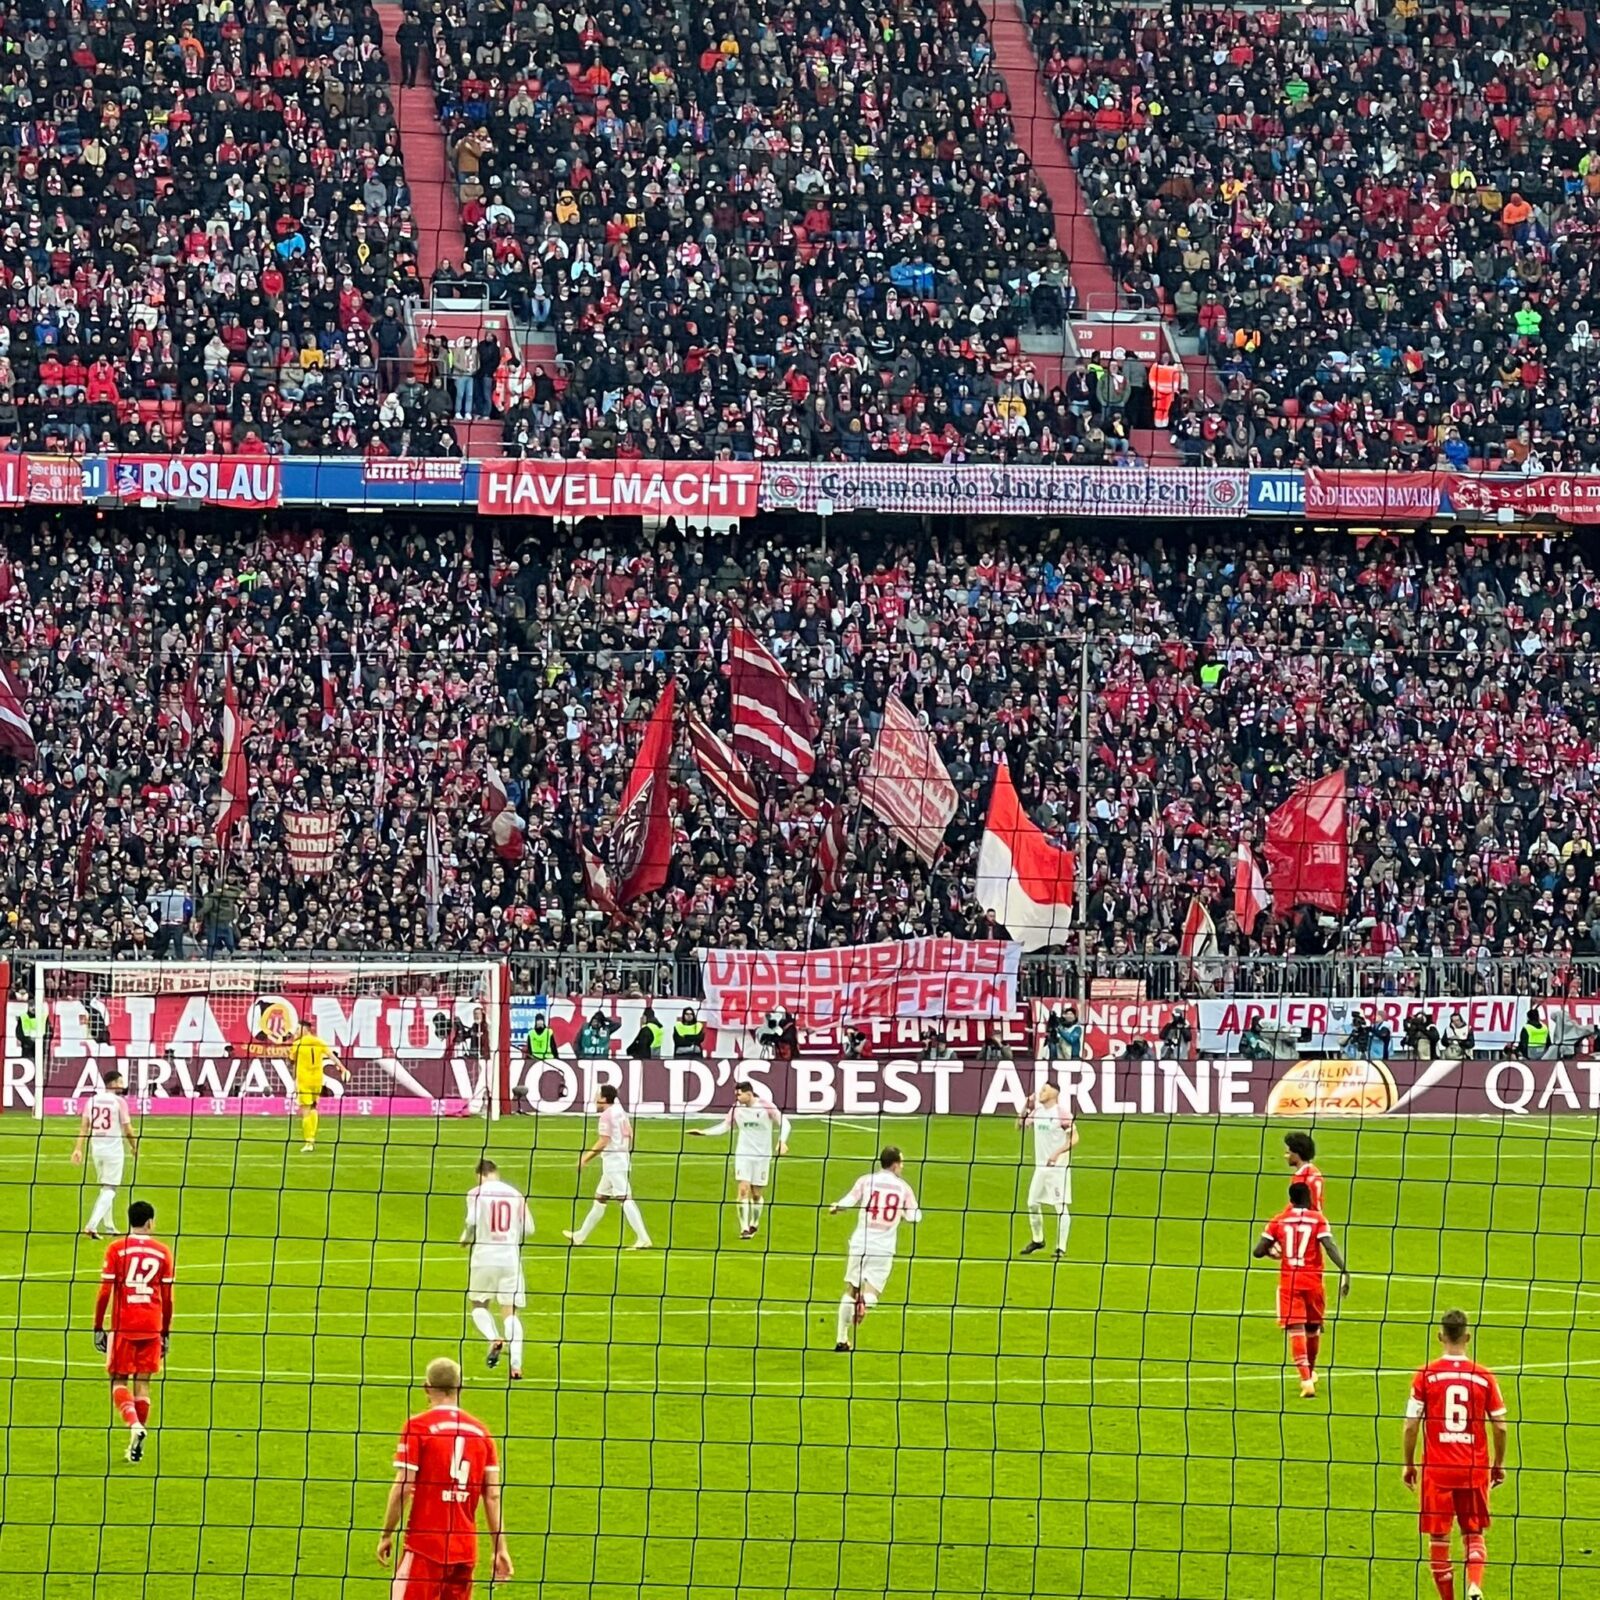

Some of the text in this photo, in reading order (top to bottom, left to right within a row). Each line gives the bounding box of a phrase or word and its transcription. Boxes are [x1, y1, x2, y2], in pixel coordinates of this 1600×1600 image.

[1078, 330, 1093, 340] 219
[142, 459, 275, 501] RÖSLAU
[367, 463, 462, 479] LETZTE REIHE
[821, 473, 978, 500] Commando
[488, 473, 753, 506] HAVELMACHT
[1387, 486, 1441, 507] BAVARIA
[795, 1059, 964, 1115] BEST
[980, 1059, 1255, 1115] AIRLINE
[1302, 1064, 1364, 1080] AIRLINE
[92, 1106, 112, 1130] 23
[1279, 1096, 1383, 1109] SKYTRAX
[490, 1200, 512, 1232] 10
[867, 1190, 900, 1222] 48
[1284, 1224, 1313, 1259] 17
[125, 1256, 160, 1295] 42
[1444, 1384, 1469, 1433] 6
[450, 1435, 471, 1490] 4
